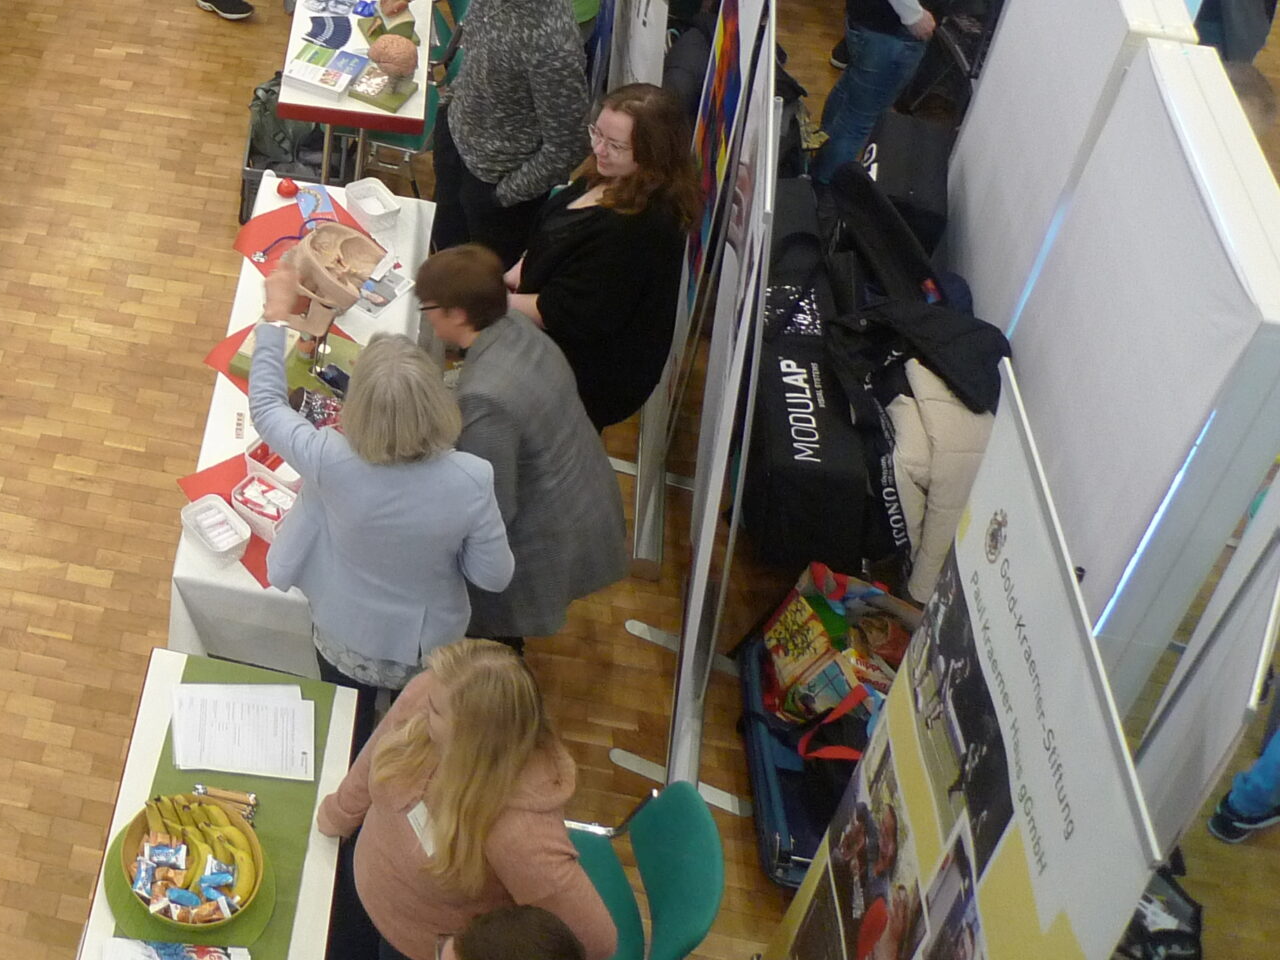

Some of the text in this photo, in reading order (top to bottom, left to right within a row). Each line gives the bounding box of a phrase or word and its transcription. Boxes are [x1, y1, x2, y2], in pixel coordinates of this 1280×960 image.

[780, 358, 821, 463] MODULAP
[969, 570, 1048, 877] Paul Kraemer Haus gGmbH
[999, 557, 1074, 841] Gold-Kraemer-Stiftung
